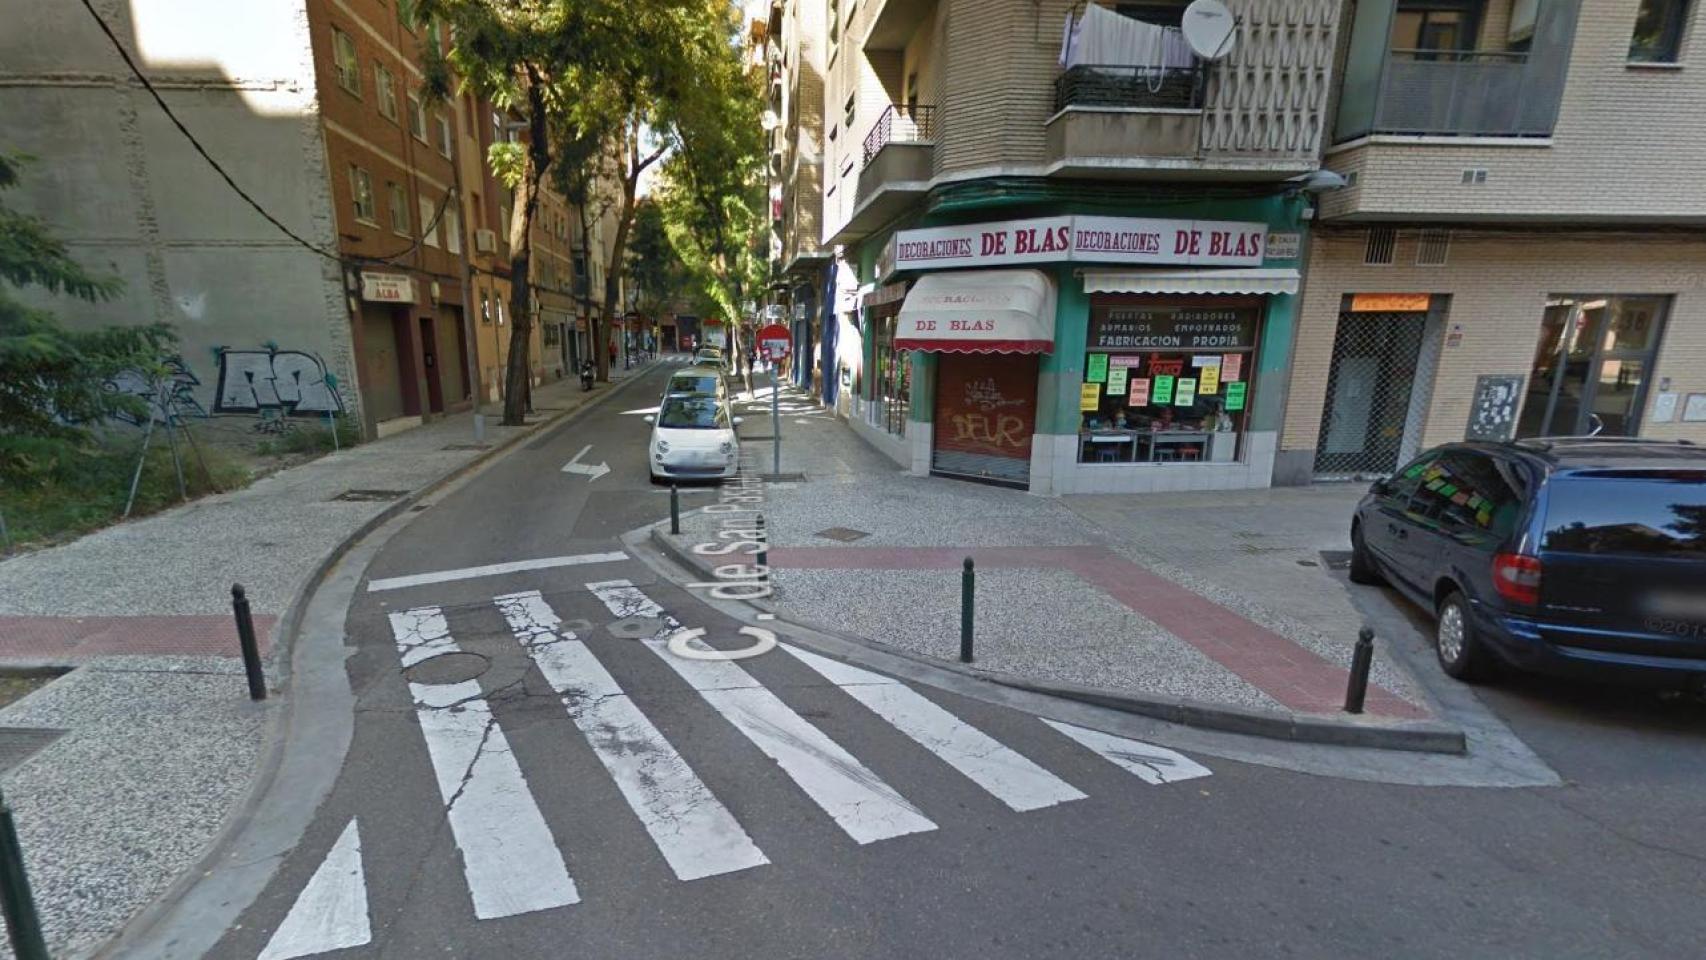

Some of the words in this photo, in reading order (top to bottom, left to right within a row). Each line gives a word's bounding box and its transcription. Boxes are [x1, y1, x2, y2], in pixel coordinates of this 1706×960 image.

[899, 238, 973, 259] DECORACIONES
[980, 232, 1007, 257] DE
[1014, 226, 1070, 255] BLAS
[1075, 230, 1161, 252] DECORACIONES
[1173, 230, 1202, 255] DE
[1208, 232, 1261, 257] BLAS
[915, 320, 937, 331] DE
[950, 320, 995, 331] BLAS
[1099, 336, 1180, 346] FABRICACION
[1192, 335, 1239, 346] PROPIA
